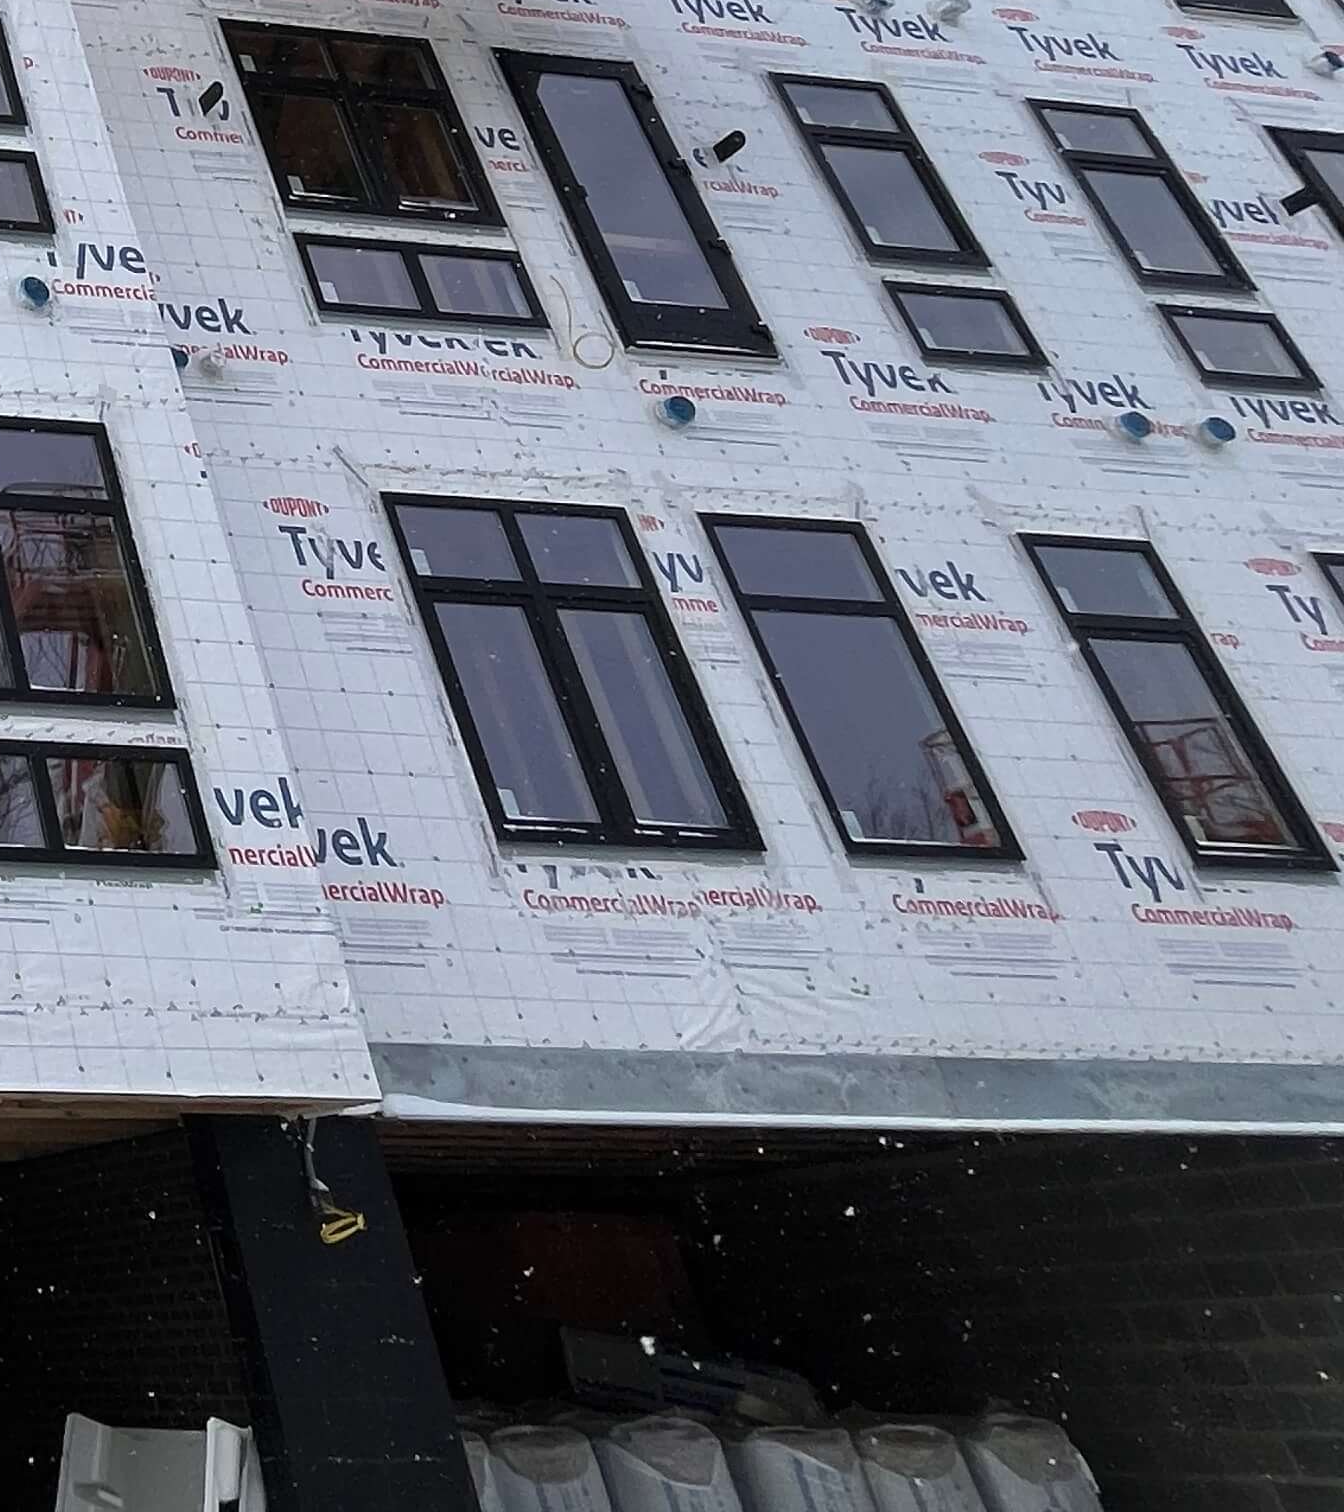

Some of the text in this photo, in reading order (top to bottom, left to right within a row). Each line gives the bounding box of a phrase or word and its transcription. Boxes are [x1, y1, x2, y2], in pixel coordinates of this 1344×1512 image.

[497, 1, 625, 29] CommercialWrap
[835, 7, 949, 42] Tyvek
[1012, 27, 1121, 62] Tyvek
[1177, 45, 1285, 79] Tyvek
